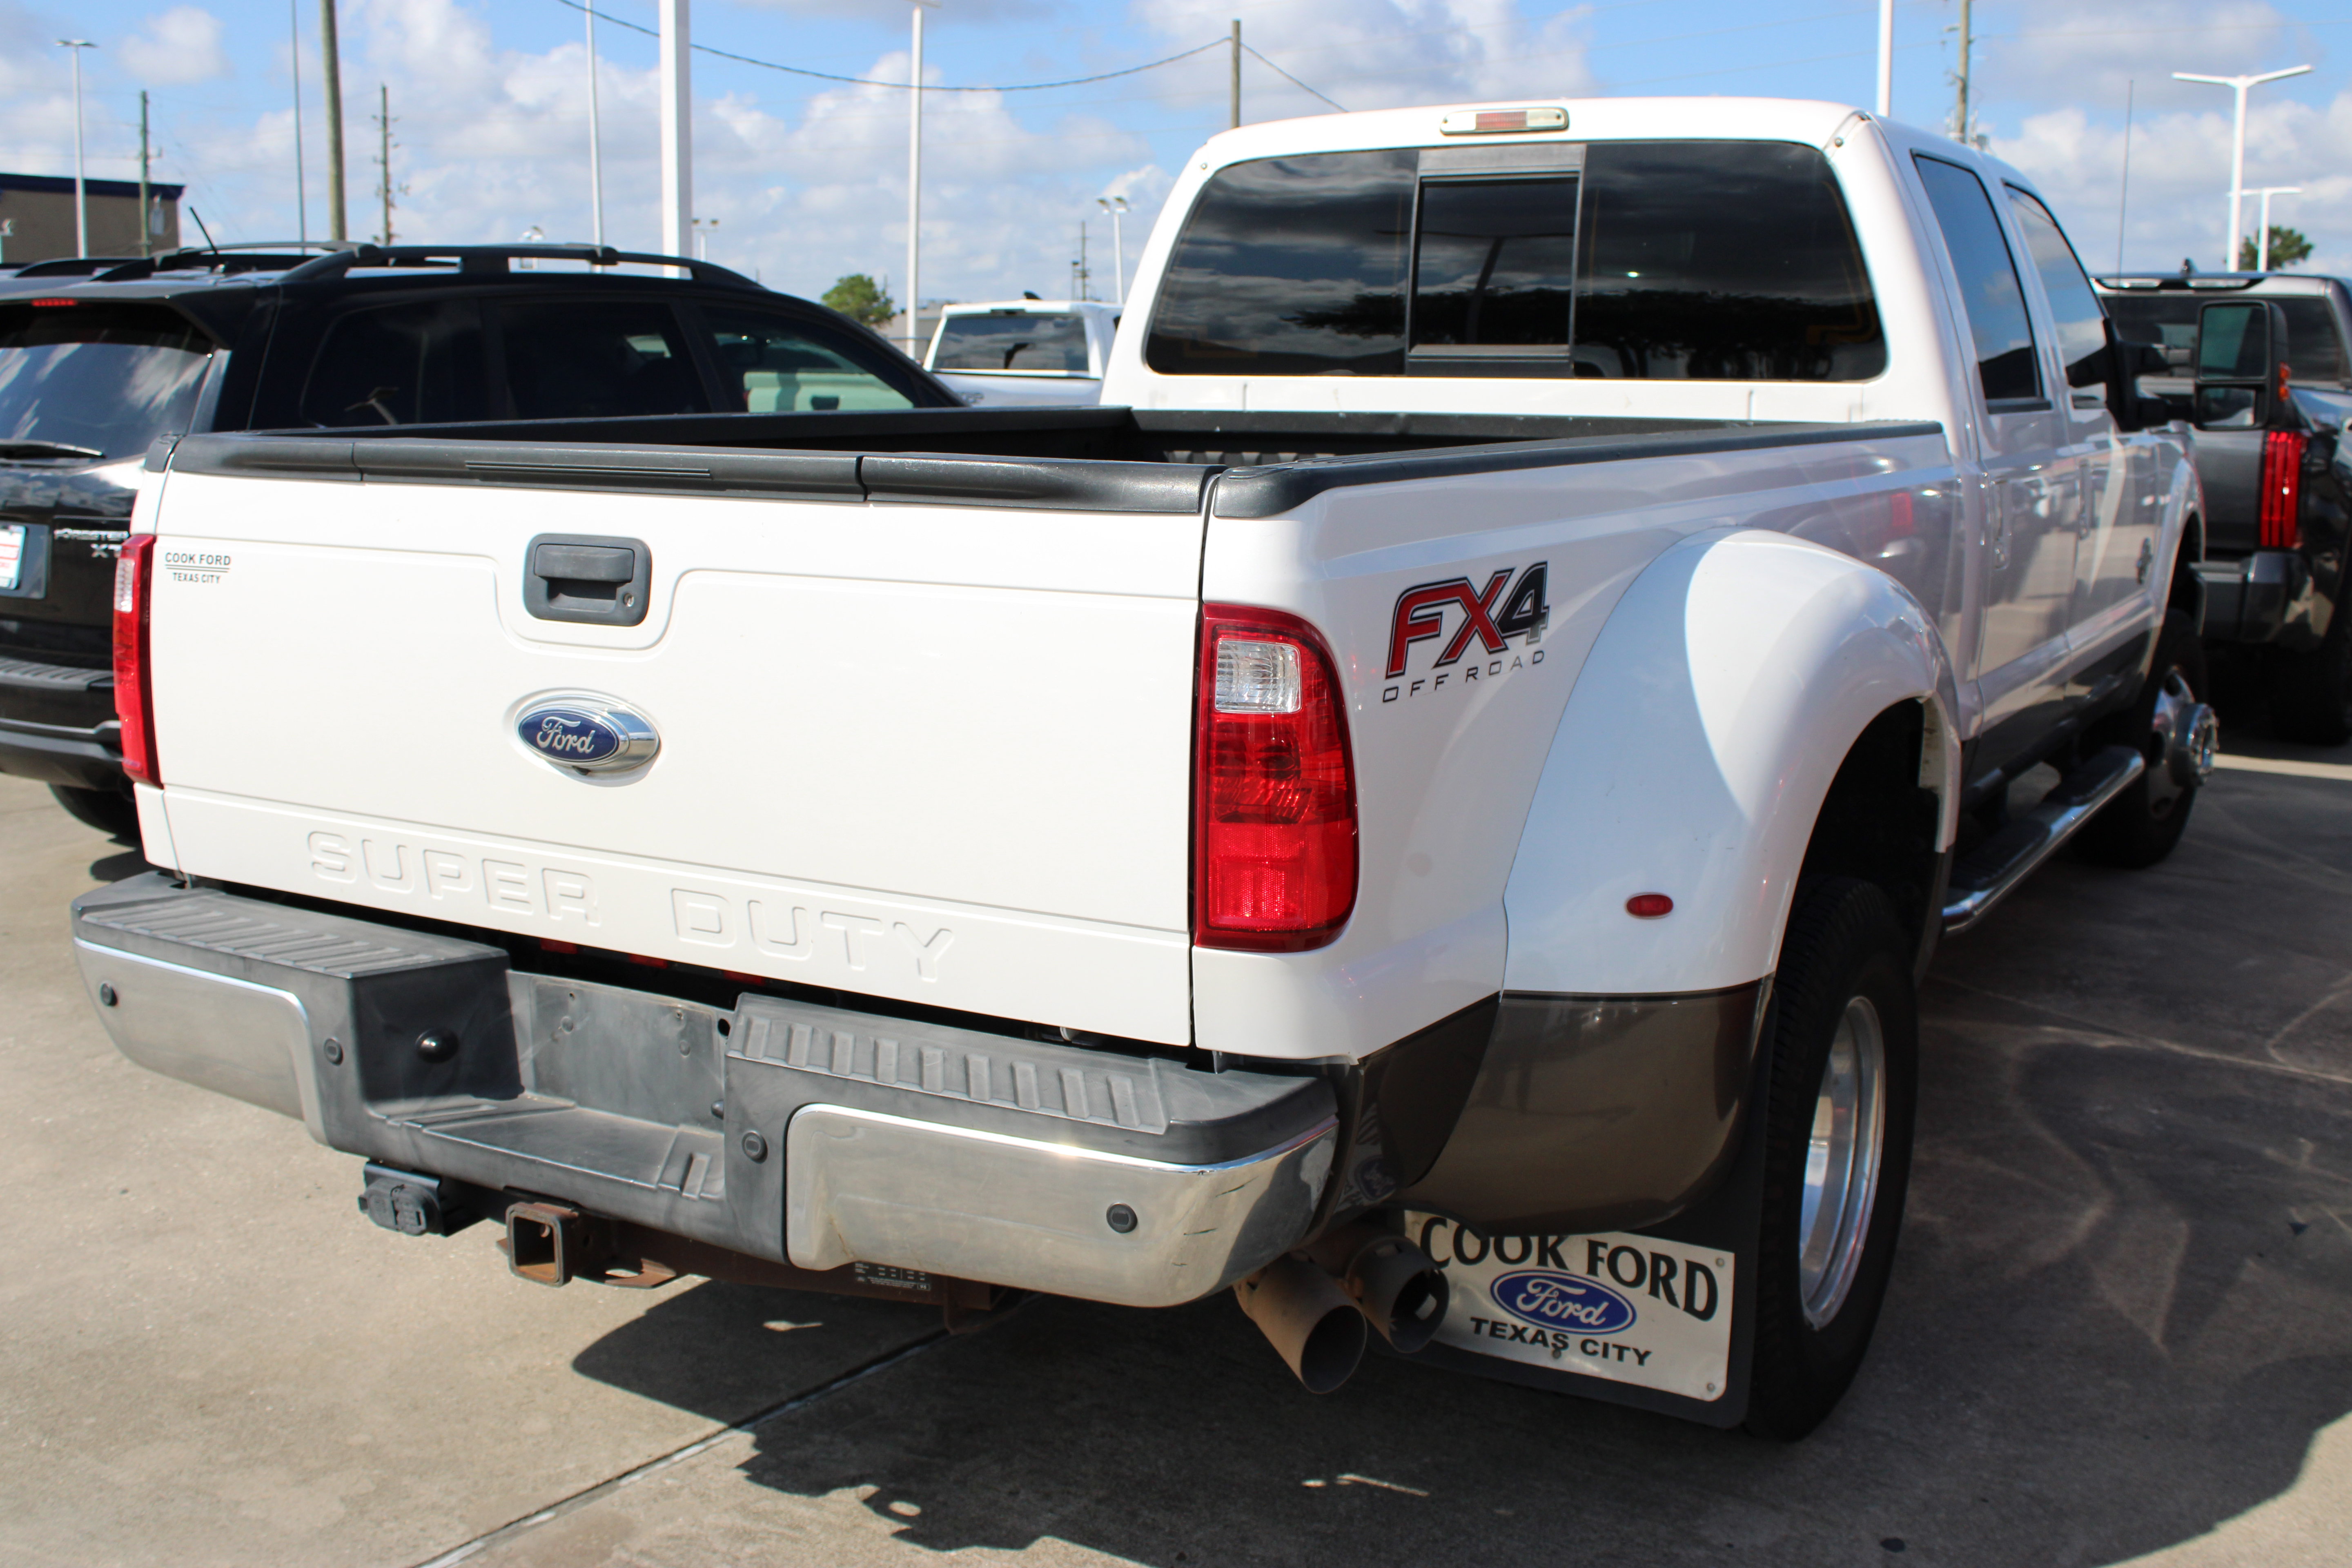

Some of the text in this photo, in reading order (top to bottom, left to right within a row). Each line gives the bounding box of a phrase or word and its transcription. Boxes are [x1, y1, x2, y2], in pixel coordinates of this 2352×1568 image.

[165, 552, 231, 566] COOK FORD
[172, 572, 221, 584] TEXAS CITY
[1385, 560, 1550, 680] FX4
[536, 716, 595, 754] Ford
[307, 831, 955, 983] SUPER DUTY
[1419, 1216, 1718, 1322] COOK FORD
[1516, 1278, 1609, 1326] Ford
[1470, 1316, 1652, 1366] TEXAS CITY
